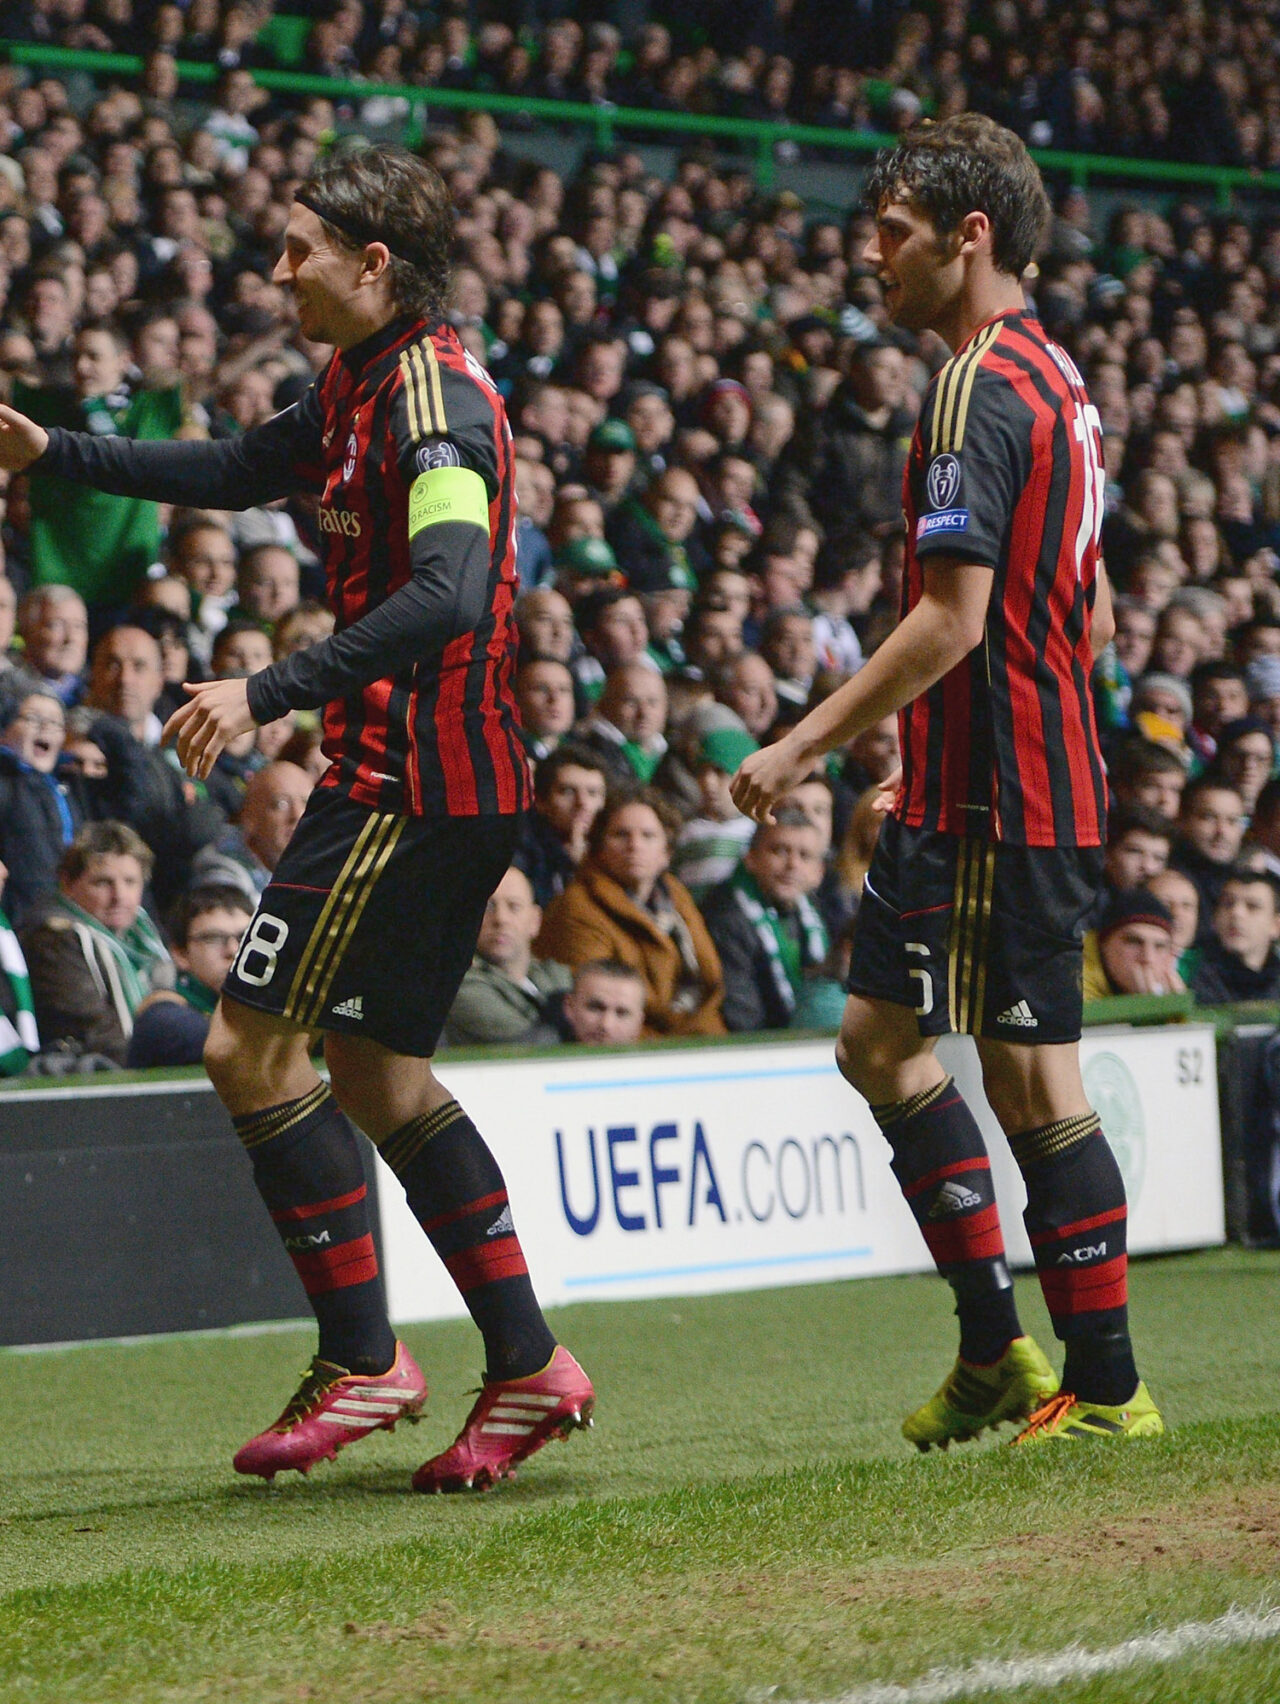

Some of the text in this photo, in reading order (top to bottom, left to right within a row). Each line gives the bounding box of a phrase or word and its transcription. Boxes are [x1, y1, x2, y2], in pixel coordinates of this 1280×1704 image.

[939, 480, 948, 495] 7
[417, 501, 451, 519] RACISM
[926, 514, 968, 530] RESPECT
[331, 1006, 365, 1020] adidas
[996, 1013, 1039, 1028] adidas
[1177, 1048, 1202, 1086] S2
[555, 1120, 866, 1236] UEFA.com
[285, 1229, 332, 1249] ACM
[1056, 1241, 1107, 1264] ACM
